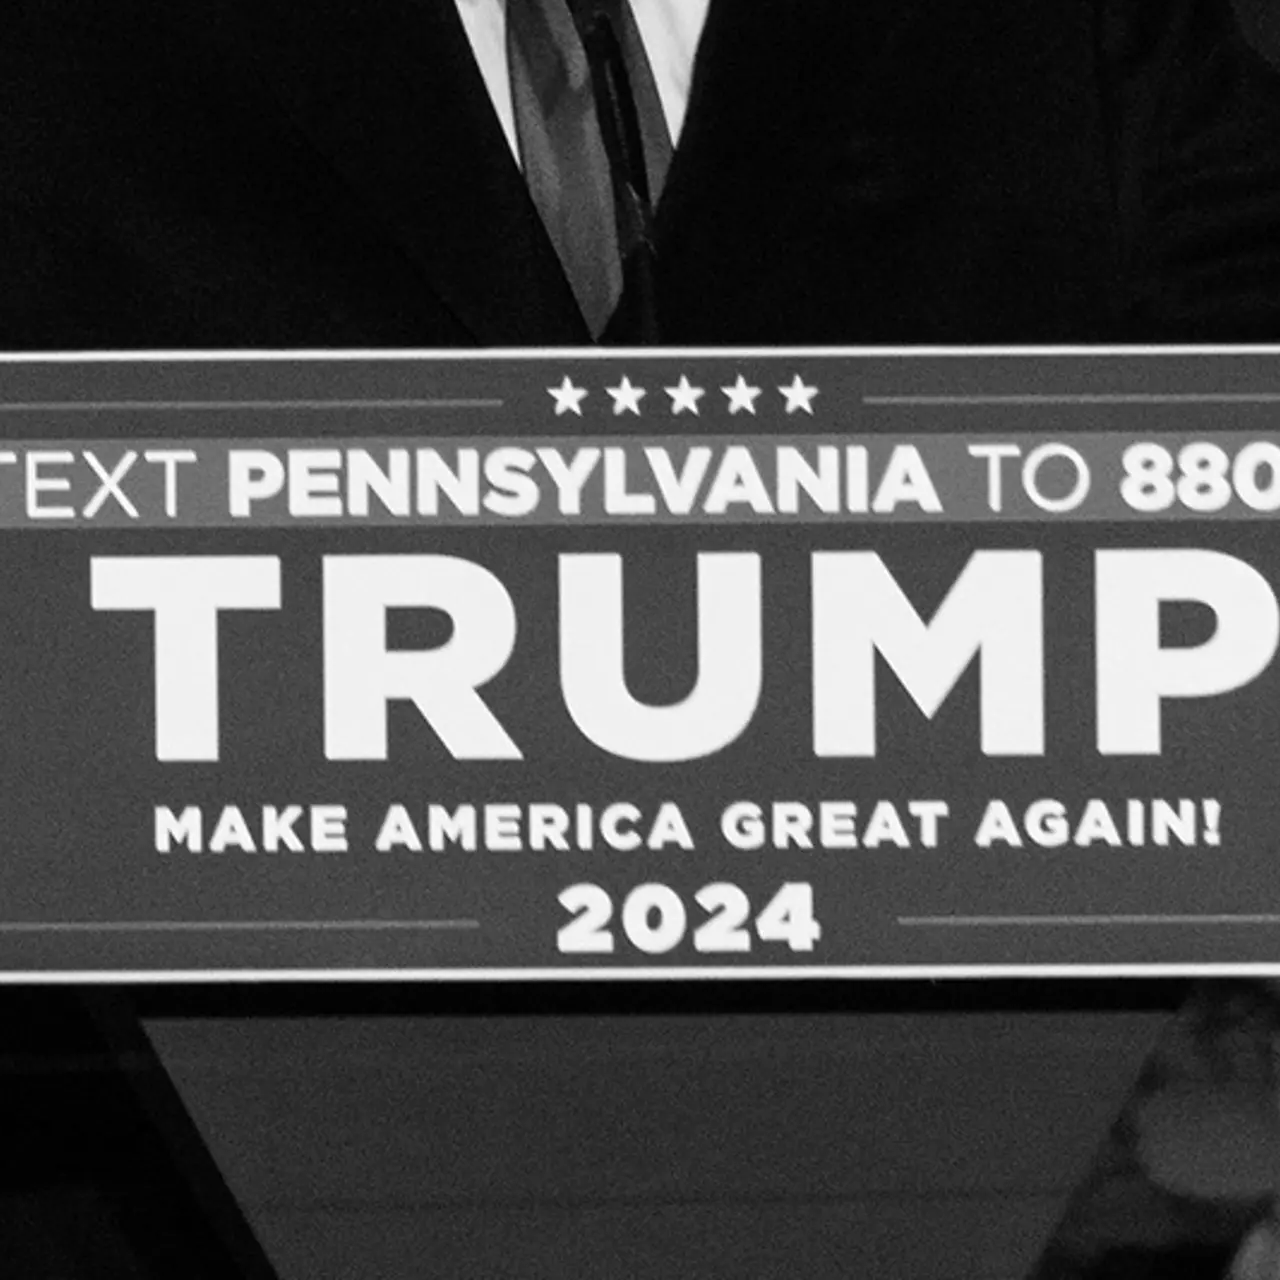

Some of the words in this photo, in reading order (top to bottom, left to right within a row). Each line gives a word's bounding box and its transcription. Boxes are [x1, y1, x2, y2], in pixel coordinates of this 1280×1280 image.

[228, 444, 943, 518] PENNSYLVANIA
[968, 442, 1091, 514] TO
[154, 804, 348, 854] MAKE
[376, 802, 695, 853] AMERICA
[721, 800, 950, 850] GREAT
[975, 798, 1222, 848] AGAIN!
[557, 882, 822, 954] 2024
